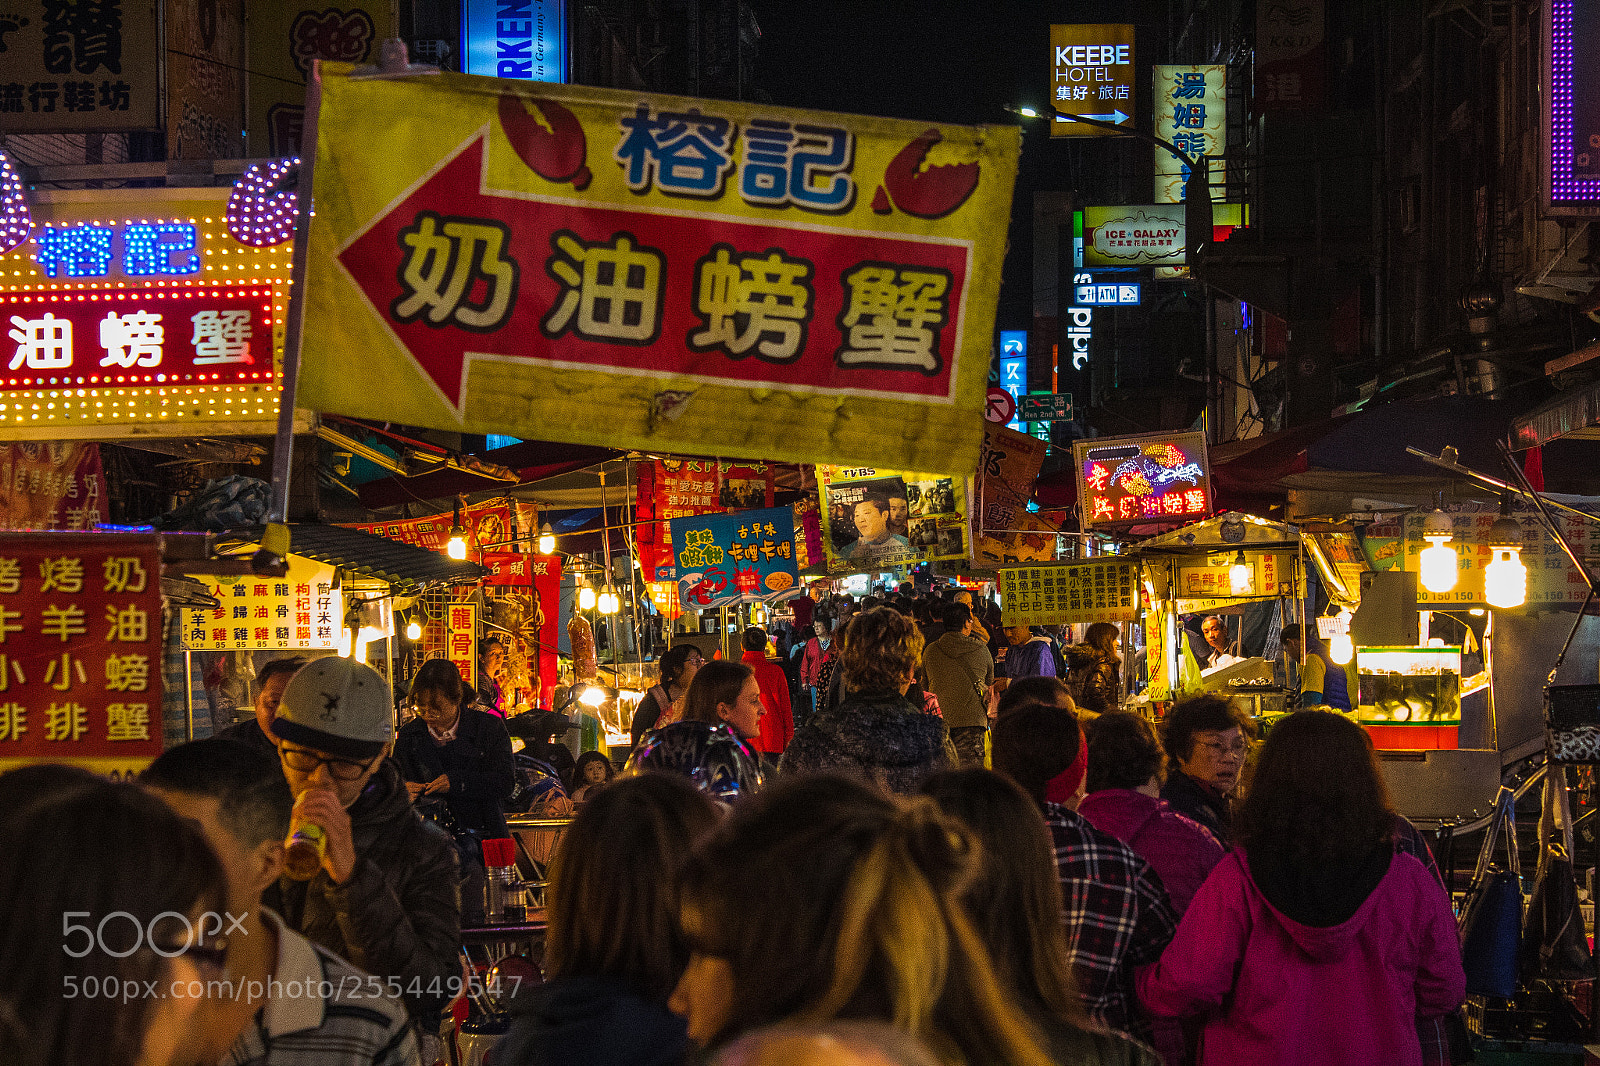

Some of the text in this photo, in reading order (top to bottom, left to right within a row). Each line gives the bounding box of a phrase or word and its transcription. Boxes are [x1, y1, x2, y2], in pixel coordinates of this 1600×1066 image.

[536, 12, 546, 61] Germany
[1055, 44, 1130, 66] KEEBE
[1056, 67, 1114, 82] HOTEL
[613, 103, 855, 213] 榕記
[1105, 229, 1180, 239] ICE GALAXY
[37, 224, 201, 278] 榕記
[392, 212, 951, 374] 奶油螃蟹
[1099, 288, 1116, 301] ATM
[8, 310, 255, 370] 油螃蟹
[1024, 411, 1038, 419] Ren
[842, 468, 876, 478] TVBS
[679, 480, 715, 493] 愛玩客
[668, 495, 712, 506] 強力推薦
[684, 528, 714, 546] 美味
[737, 522, 777, 539] 古早味
[679, 544, 724, 568] 蝦餅
[491, 561, 549, 576] 石頭蝦
[1005, 570, 1017, 613] 奶油魚片
[1432, 592, 1451, 601] 150
[1455, 592, 1474, 601] 150
[1545, 591, 1563, 600] 150
[1567, 591, 1586, 600] 150
[274, 583, 290, 639] 龍骨髓
[295, 583, 311, 639] 枸杞豬腦
[316, 583, 332, 639] 筒仔米糕
[1179, 603, 1194, 611] 150
[1202, 599, 1216, 607] 150
[232, 584, 248, 641] 當歸雞
[253, 584, 269, 641] 麻油雞
[39, 556, 88, 741] 烤羊小排
[102, 556, 150, 741] 奶油螃蟹
[1150, 686, 1164, 698] 200
